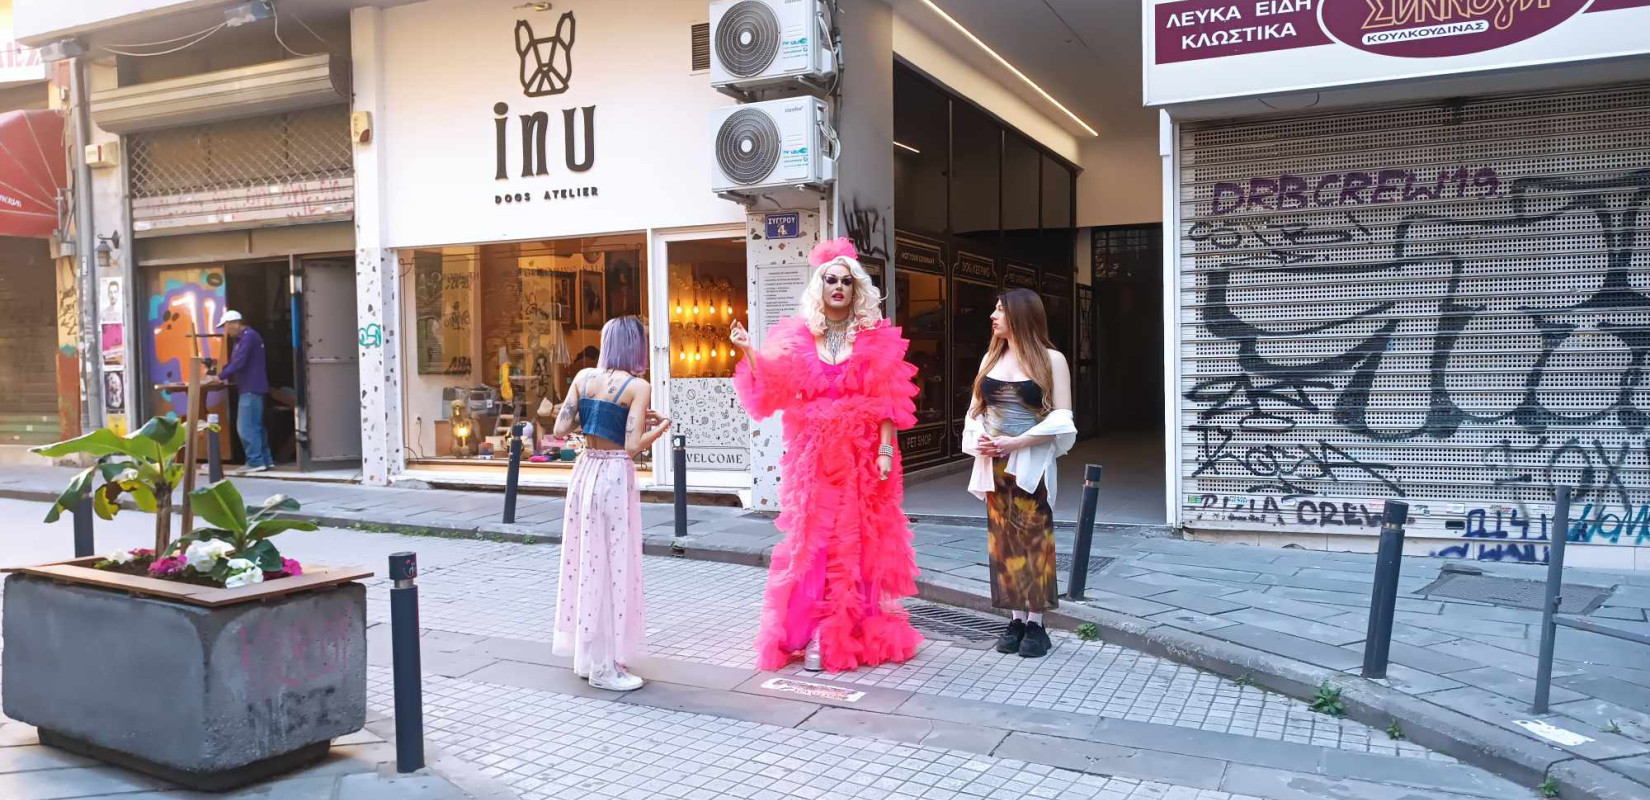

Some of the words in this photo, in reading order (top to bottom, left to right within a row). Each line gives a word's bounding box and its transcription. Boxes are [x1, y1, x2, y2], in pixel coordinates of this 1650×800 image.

[1166, 5, 1242, 29] ΛΕΥΚΑ
[1255, 0, 1312, 17] ΕΙΔΗ
[1181, 22, 1297, 50] ΚΛΩΣΤΙΚΑ
[1366, 22, 1485, 43] ΚΟΥΛΚΟΥΔΙΝΑΣ
[494, 192, 532, 205] DOGS
[543, 186, 599, 201] ATELIER
